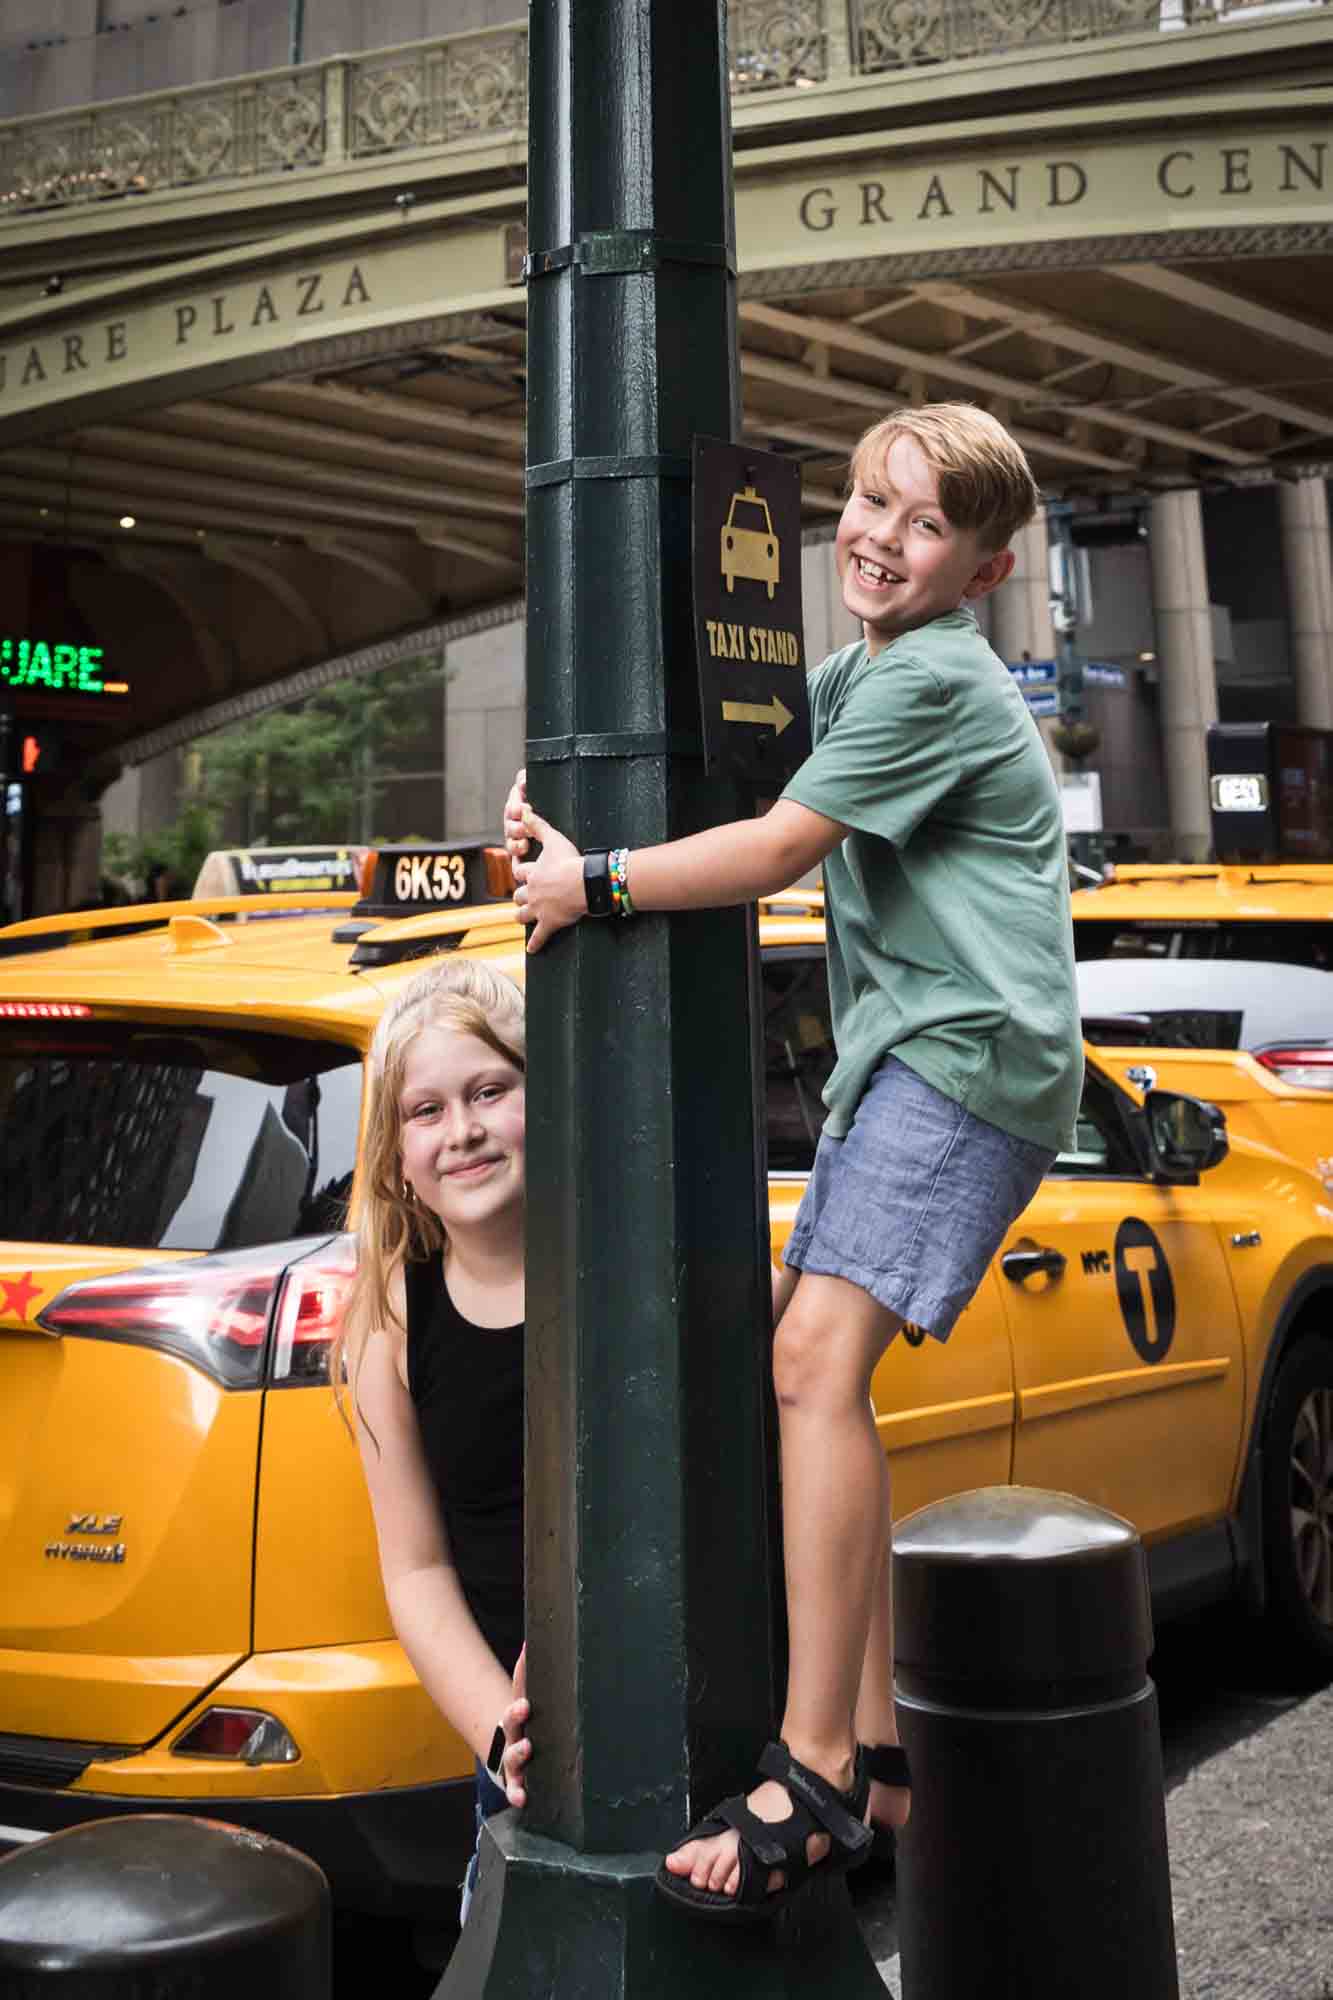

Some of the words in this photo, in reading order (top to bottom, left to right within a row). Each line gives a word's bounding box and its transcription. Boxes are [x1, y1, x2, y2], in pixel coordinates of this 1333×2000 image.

[799, 161, 1088, 232] GRAND
[1157, 142, 1329, 199] CEN
[174, 264, 372, 344] PLAZA
[705, 620, 746, 660] TAXI
[748, 626, 799, 666] STAND
[395, 855, 466, 900] 6K53
[1080, 1250, 1112, 1274] NYC
[1122, 1246, 1159, 1344] T
[65, 1513, 124, 1535] XLE
